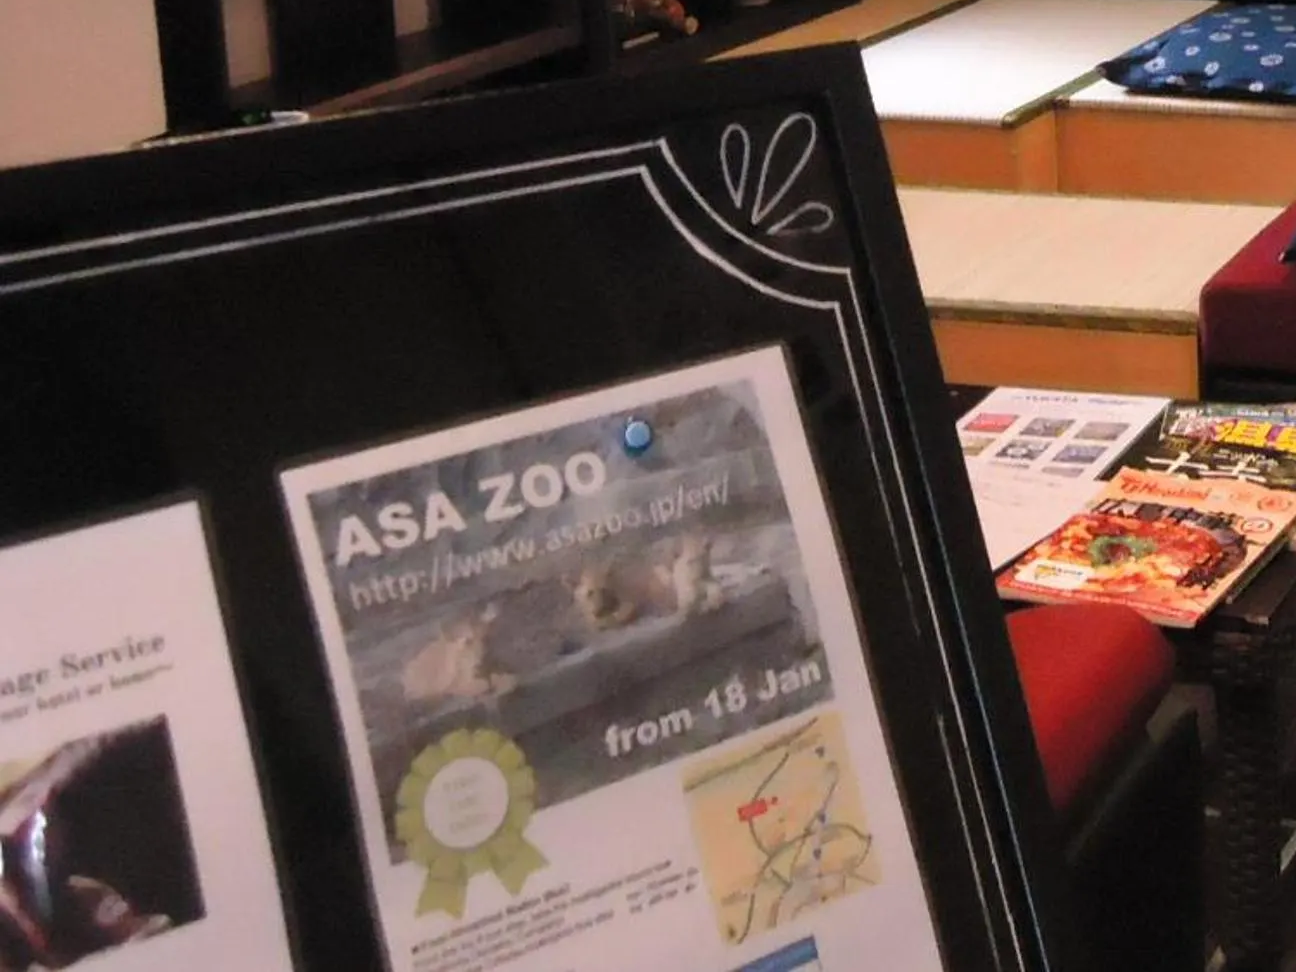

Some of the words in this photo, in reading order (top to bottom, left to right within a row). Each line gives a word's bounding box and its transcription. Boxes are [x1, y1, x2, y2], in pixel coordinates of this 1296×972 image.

[334, 492, 467, 567] ASA
[478, 451, 607, 523] ZOO
[350, 473, 729, 610] http://www.asazoo.jp/en/
[60, 635, 166, 679] Service
[604, 708, 693, 757] from
[704, 678, 748, 719] 18
[756, 661, 822, 701] Jan
